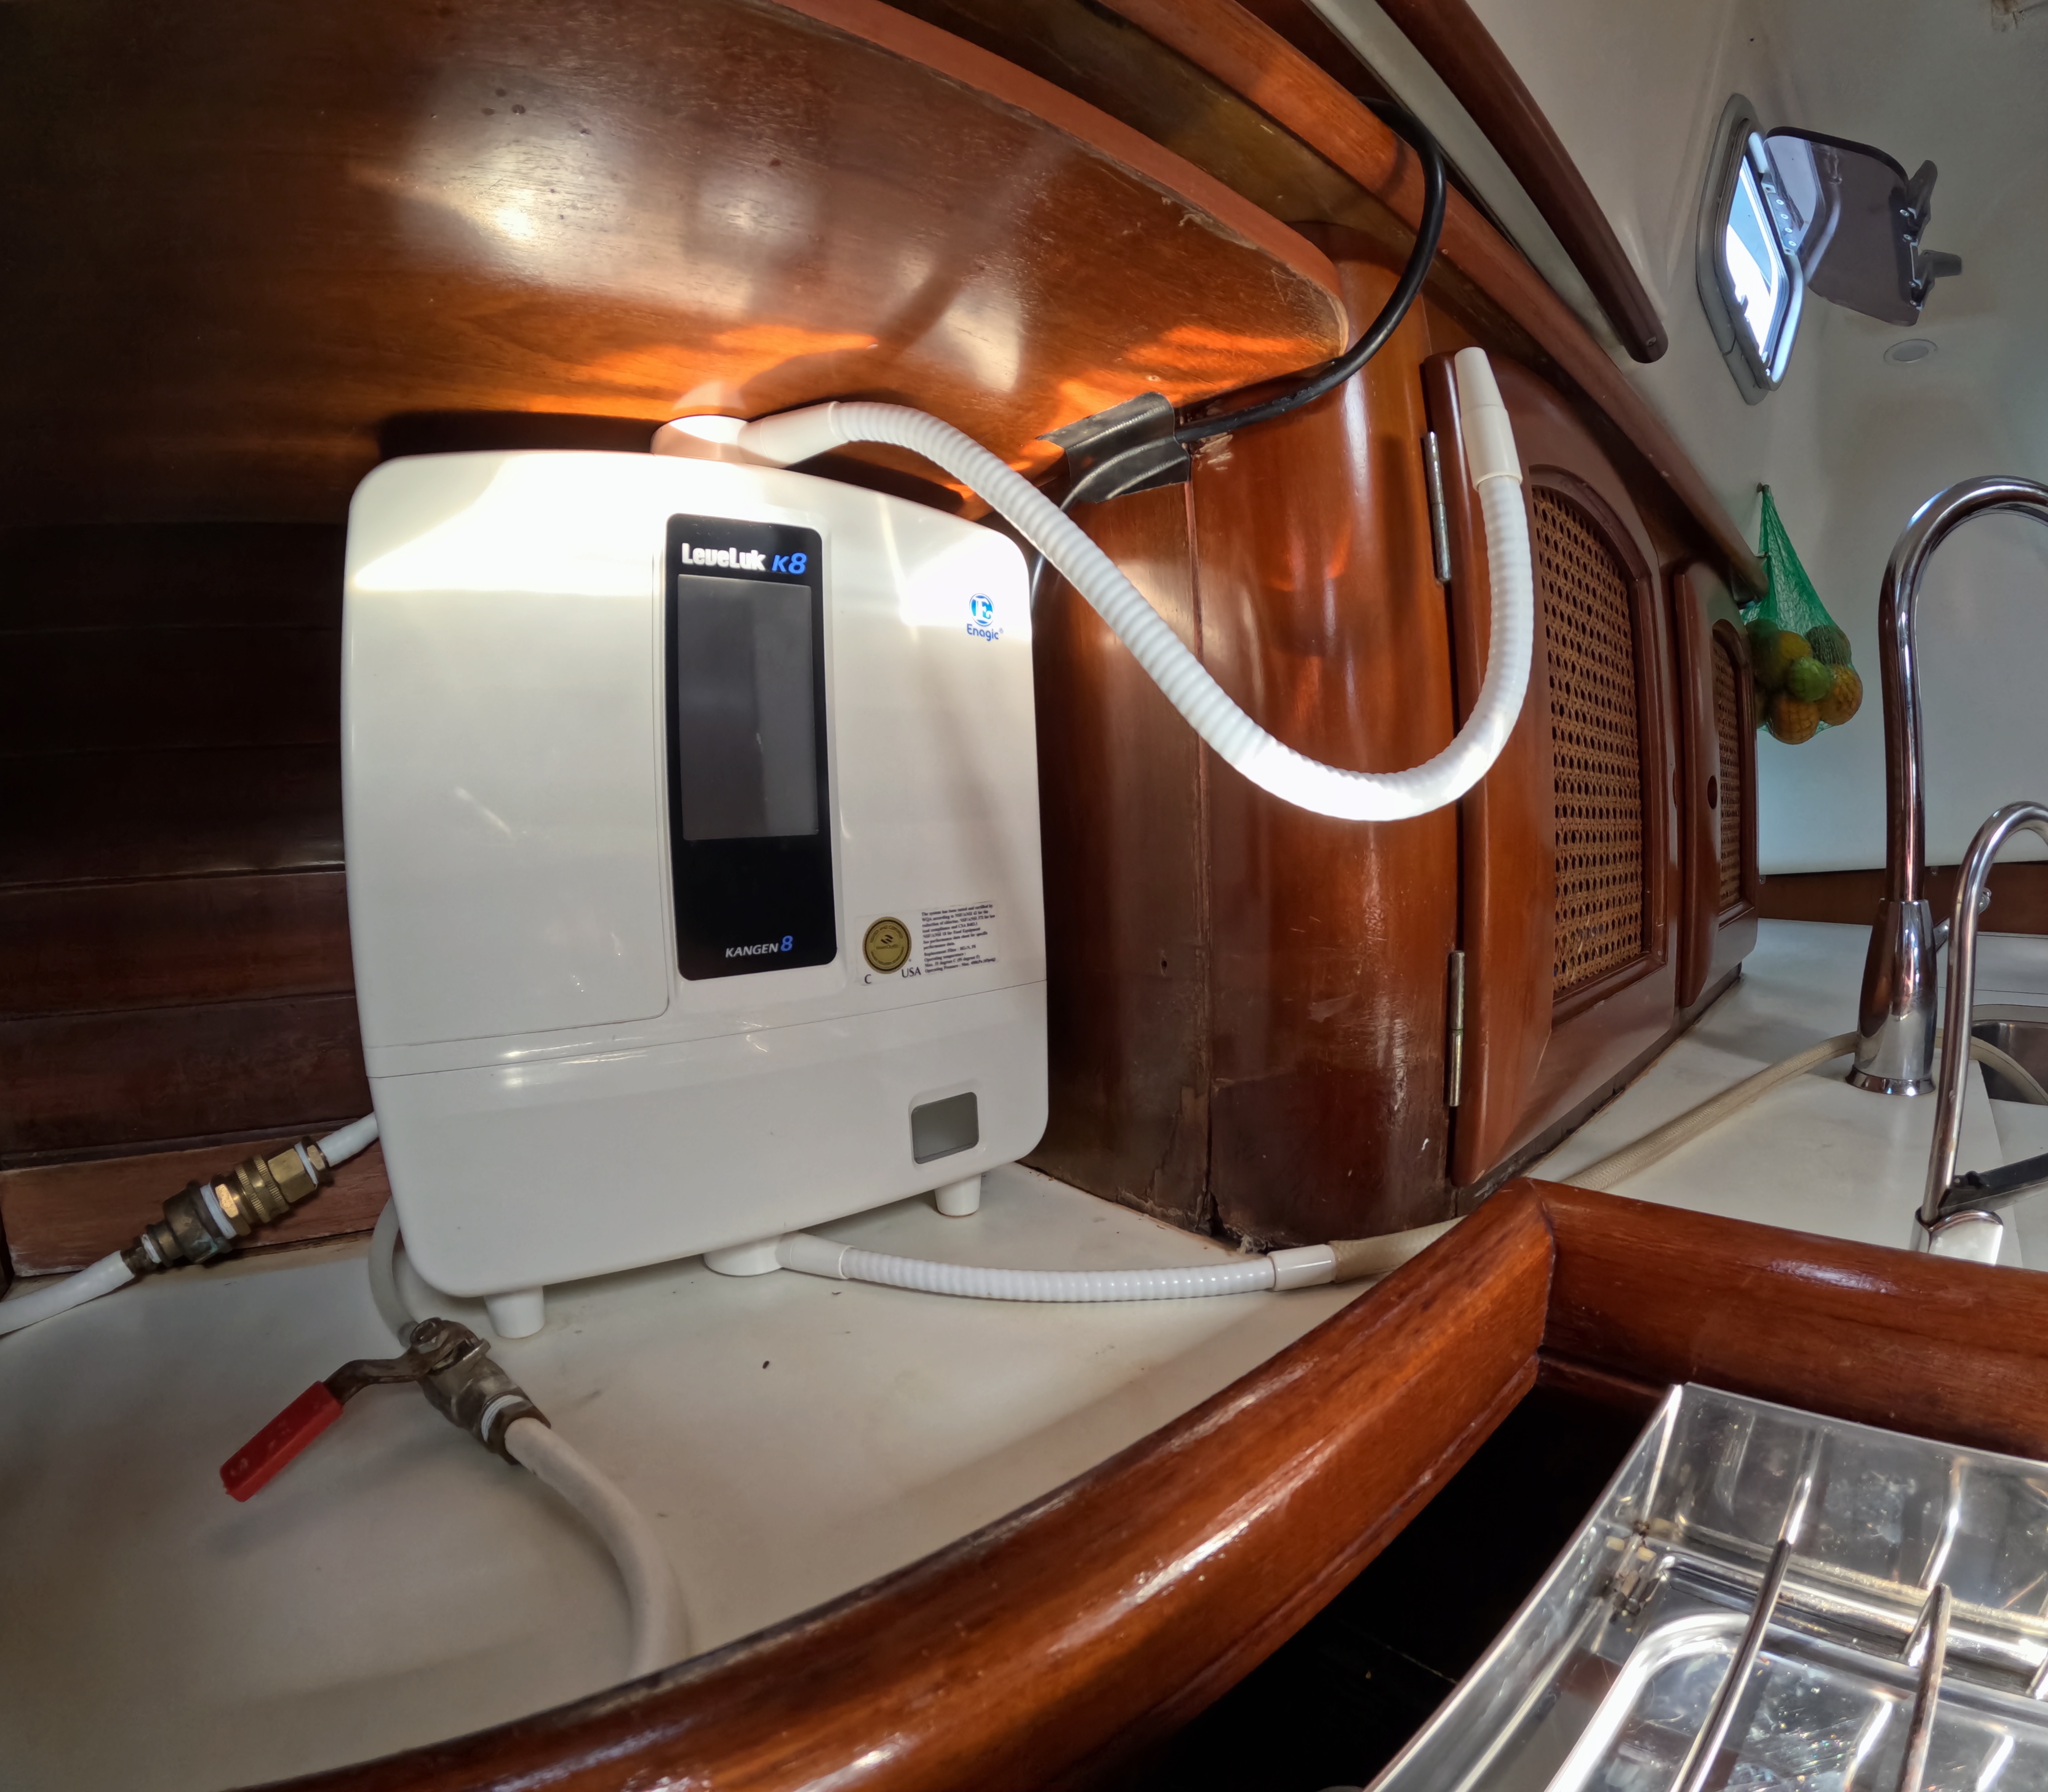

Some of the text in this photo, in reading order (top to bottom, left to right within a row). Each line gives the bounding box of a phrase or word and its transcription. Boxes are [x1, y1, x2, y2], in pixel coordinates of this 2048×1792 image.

[772, 552, 807, 575] K8
[725, 935, 793, 958] KANGEN 8
[864, 967, 921, 984] C USA
